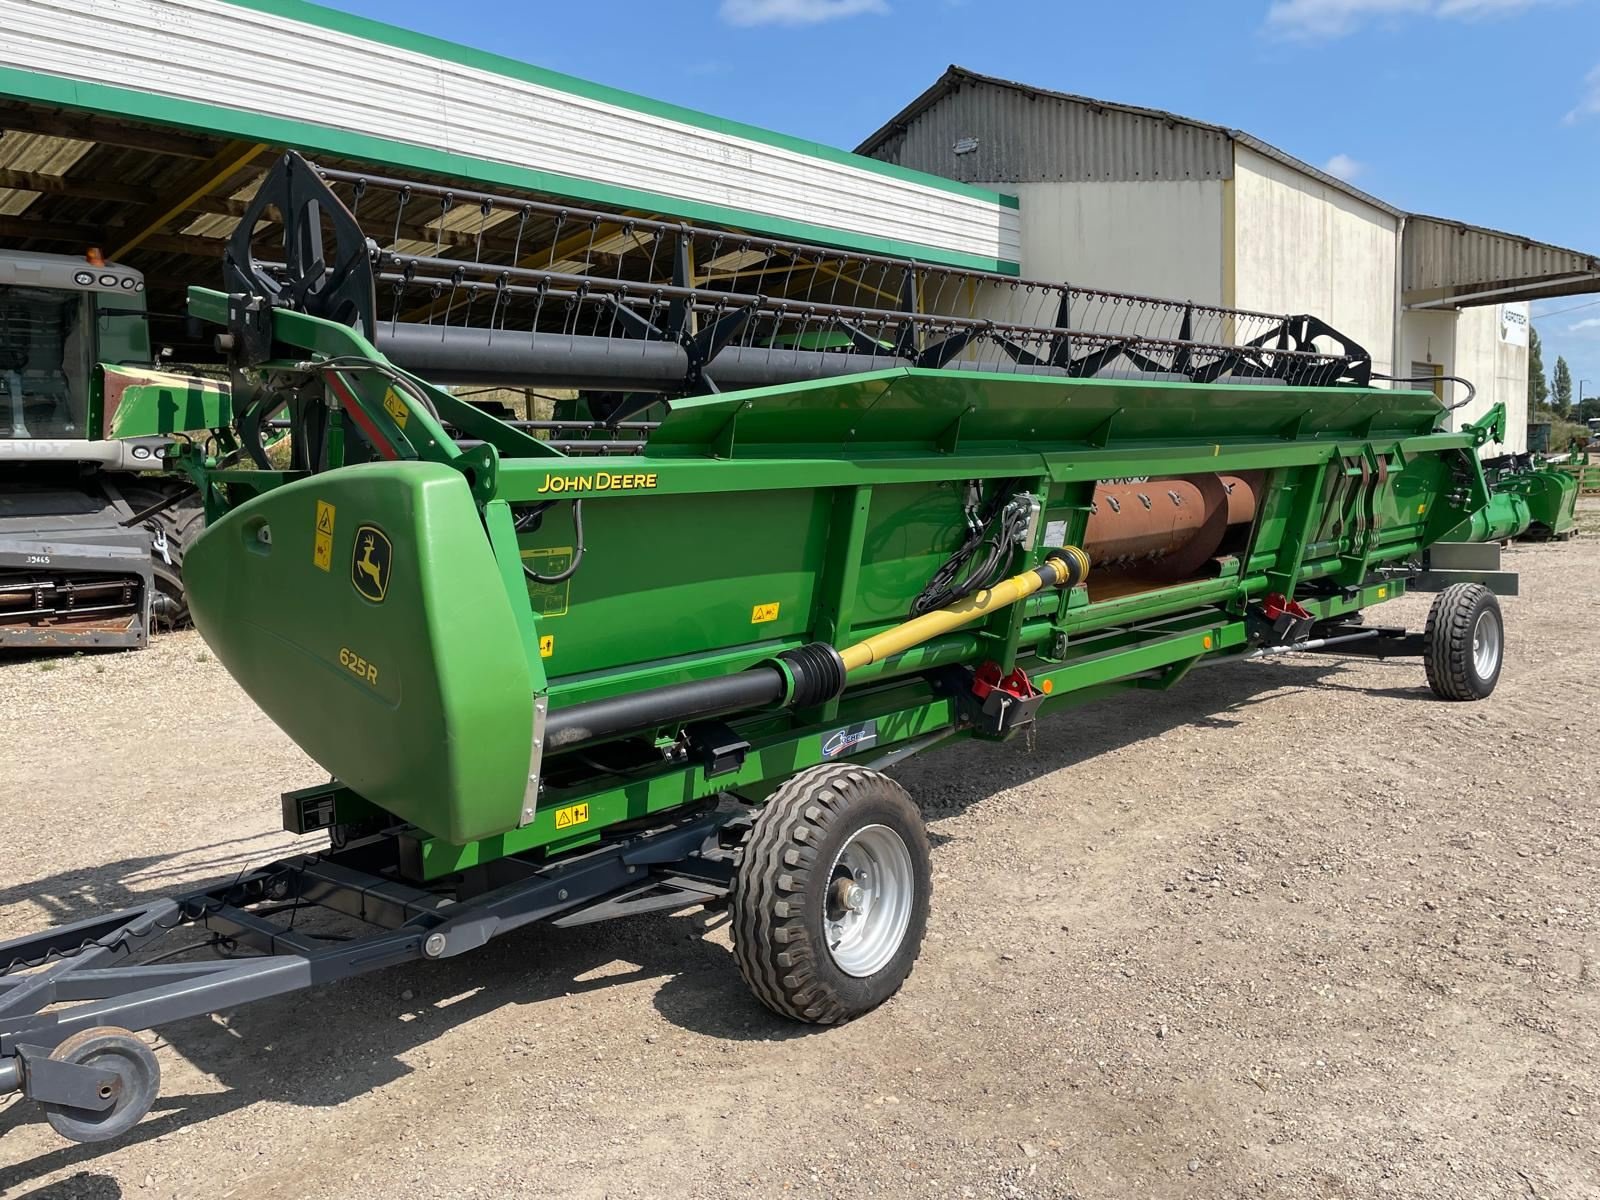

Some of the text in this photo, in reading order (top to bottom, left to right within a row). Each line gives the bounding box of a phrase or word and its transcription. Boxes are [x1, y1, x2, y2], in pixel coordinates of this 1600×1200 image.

[0, 442, 71, 454] ENDT
[537, 472, 657, 494] JOHN DEERE
[339, 647, 378, 685] 625R
